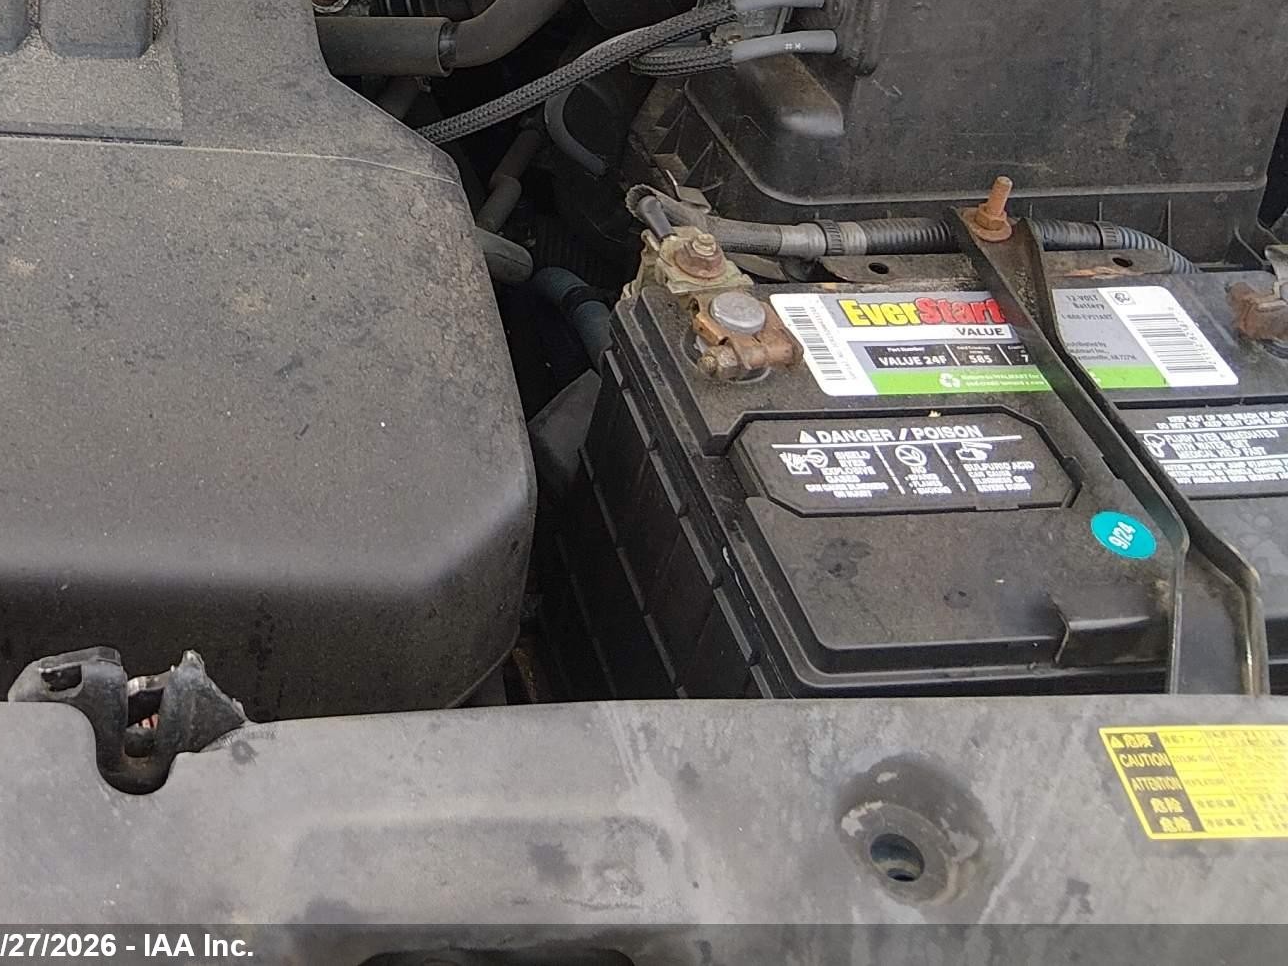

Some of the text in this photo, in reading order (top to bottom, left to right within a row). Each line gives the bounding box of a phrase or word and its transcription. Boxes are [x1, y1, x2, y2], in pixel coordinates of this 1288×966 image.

[837, 297, 1006, 328] EverStart
[957, 327, 1005, 336] VALUE
[878, 356, 921, 367] VALUE
[815, 428, 896, 444] DANGER
[910, 424, 984, 440] POISON
[1119, 752, 1171, 768] CAUTION
[1130, 776, 1183, 791] ATTENTION
